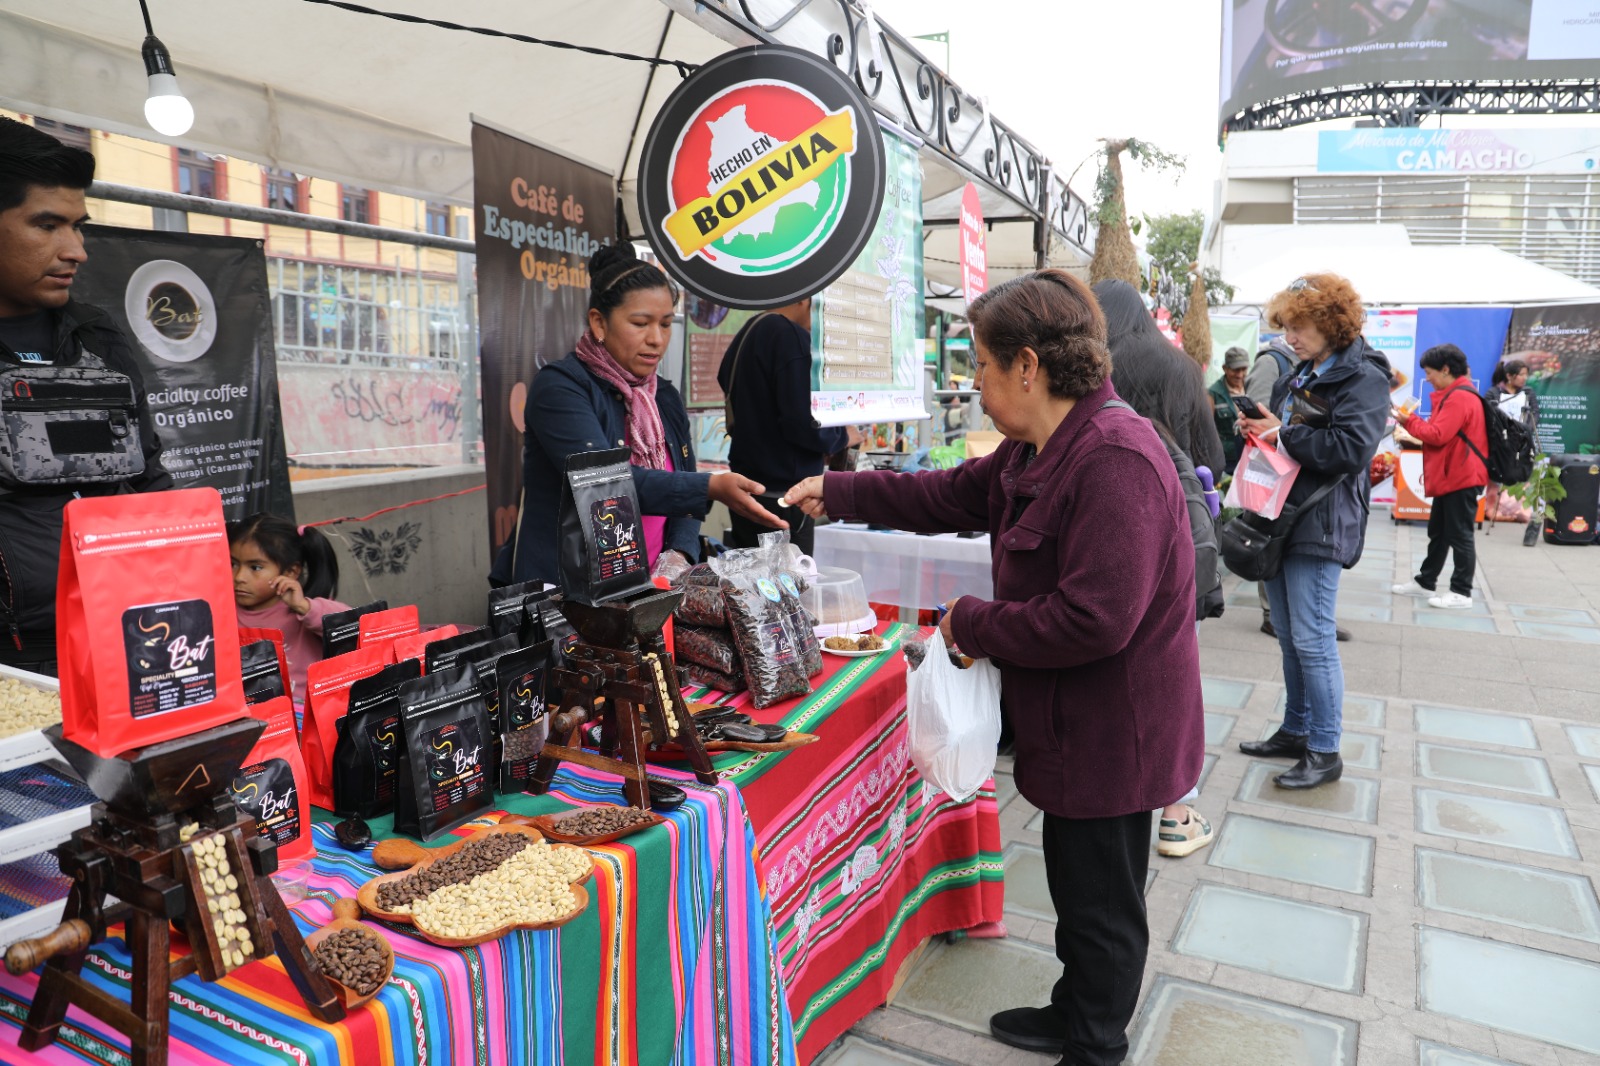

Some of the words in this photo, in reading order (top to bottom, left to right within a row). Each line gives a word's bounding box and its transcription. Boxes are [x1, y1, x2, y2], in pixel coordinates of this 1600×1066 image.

[1275, 59, 1289, 68] Por
[1308, 49, 1343, 59] nuestra
[1345, 42, 1396, 54] coyuntura
[1397, 40, 1448, 49] energética
[1349, 131, 1405, 148] Mercado
[1407, 133, 1424, 146] de
[1425, 130, 1450, 148] Mil
[1451, 131, 1495, 147] Colores
[711, 147, 753, 184] HECHO
[751, 135, 773, 156] EN
[1397, 149, 1535, 170] CAMACHO
[691, 132, 838, 236] BOLIVIA
[887, 174, 912, 209] Coffee
[511, 176, 558, 217] Café
[562, 194, 584, 224] de
[963, 228, 986, 273] Venta
[146, 296, 202, 327] Bat
[1377, 338, 1411, 346] Turismo
[147, 387, 200, 405] ecialty
[203, 383, 248, 403] coffee
[154, 408, 233, 428] Orgánico
[161, 447, 182, 458] café
[184, 443, 226, 456] orgánico
[163, 460, 182, 468] 600
[197, 455, 227, 465] s.n.m.
[242, 449, 260, 458] Villa
[170, 467, 204, 480] aturapi
[218, 483, 244, 495] atural
[245, 484, 251, 492] y
[614, 523, 637, 547] Bat
[167, 634, 215, 670] Bat
[140, 671, 175, 684] SPECIALITY
[452, 745, 484, 775] Bat
[259, 787, 297, 820] Bat
